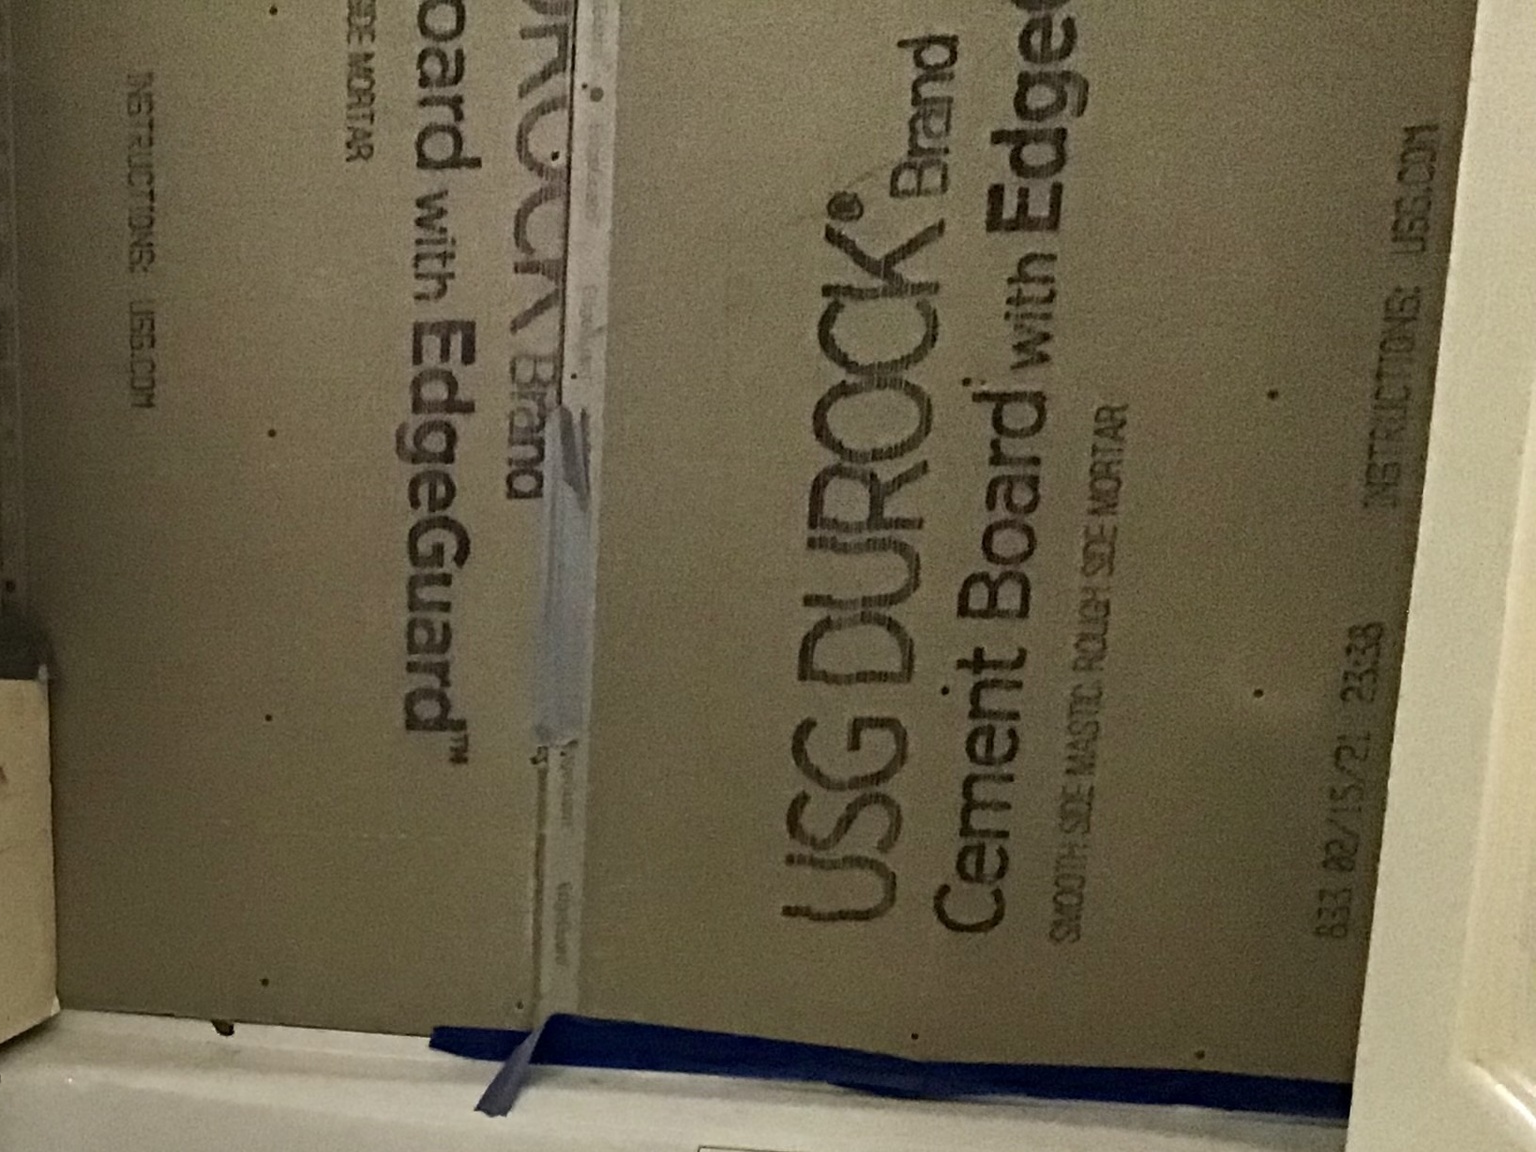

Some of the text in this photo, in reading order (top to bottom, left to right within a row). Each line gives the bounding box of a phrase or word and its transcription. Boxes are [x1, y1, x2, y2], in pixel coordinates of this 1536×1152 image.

[345, 52, 376, 163] MORTAR
[413, 189, 457, 302] with
[129, 301, 157, 410] USG.COM
[1004, 252, 1058, 370] with
[781, 716, 909, 922] USG
[889, 34, 959, 198] Brand
[956, 391, 1048, 619] Board
[1087, 403, 1129, 517] MORTAR
[1080, 526, 1118, 578] SIDE
[933, 646, 1028, 933] Cement
[1059, 784, 1095, 834] SIDE
